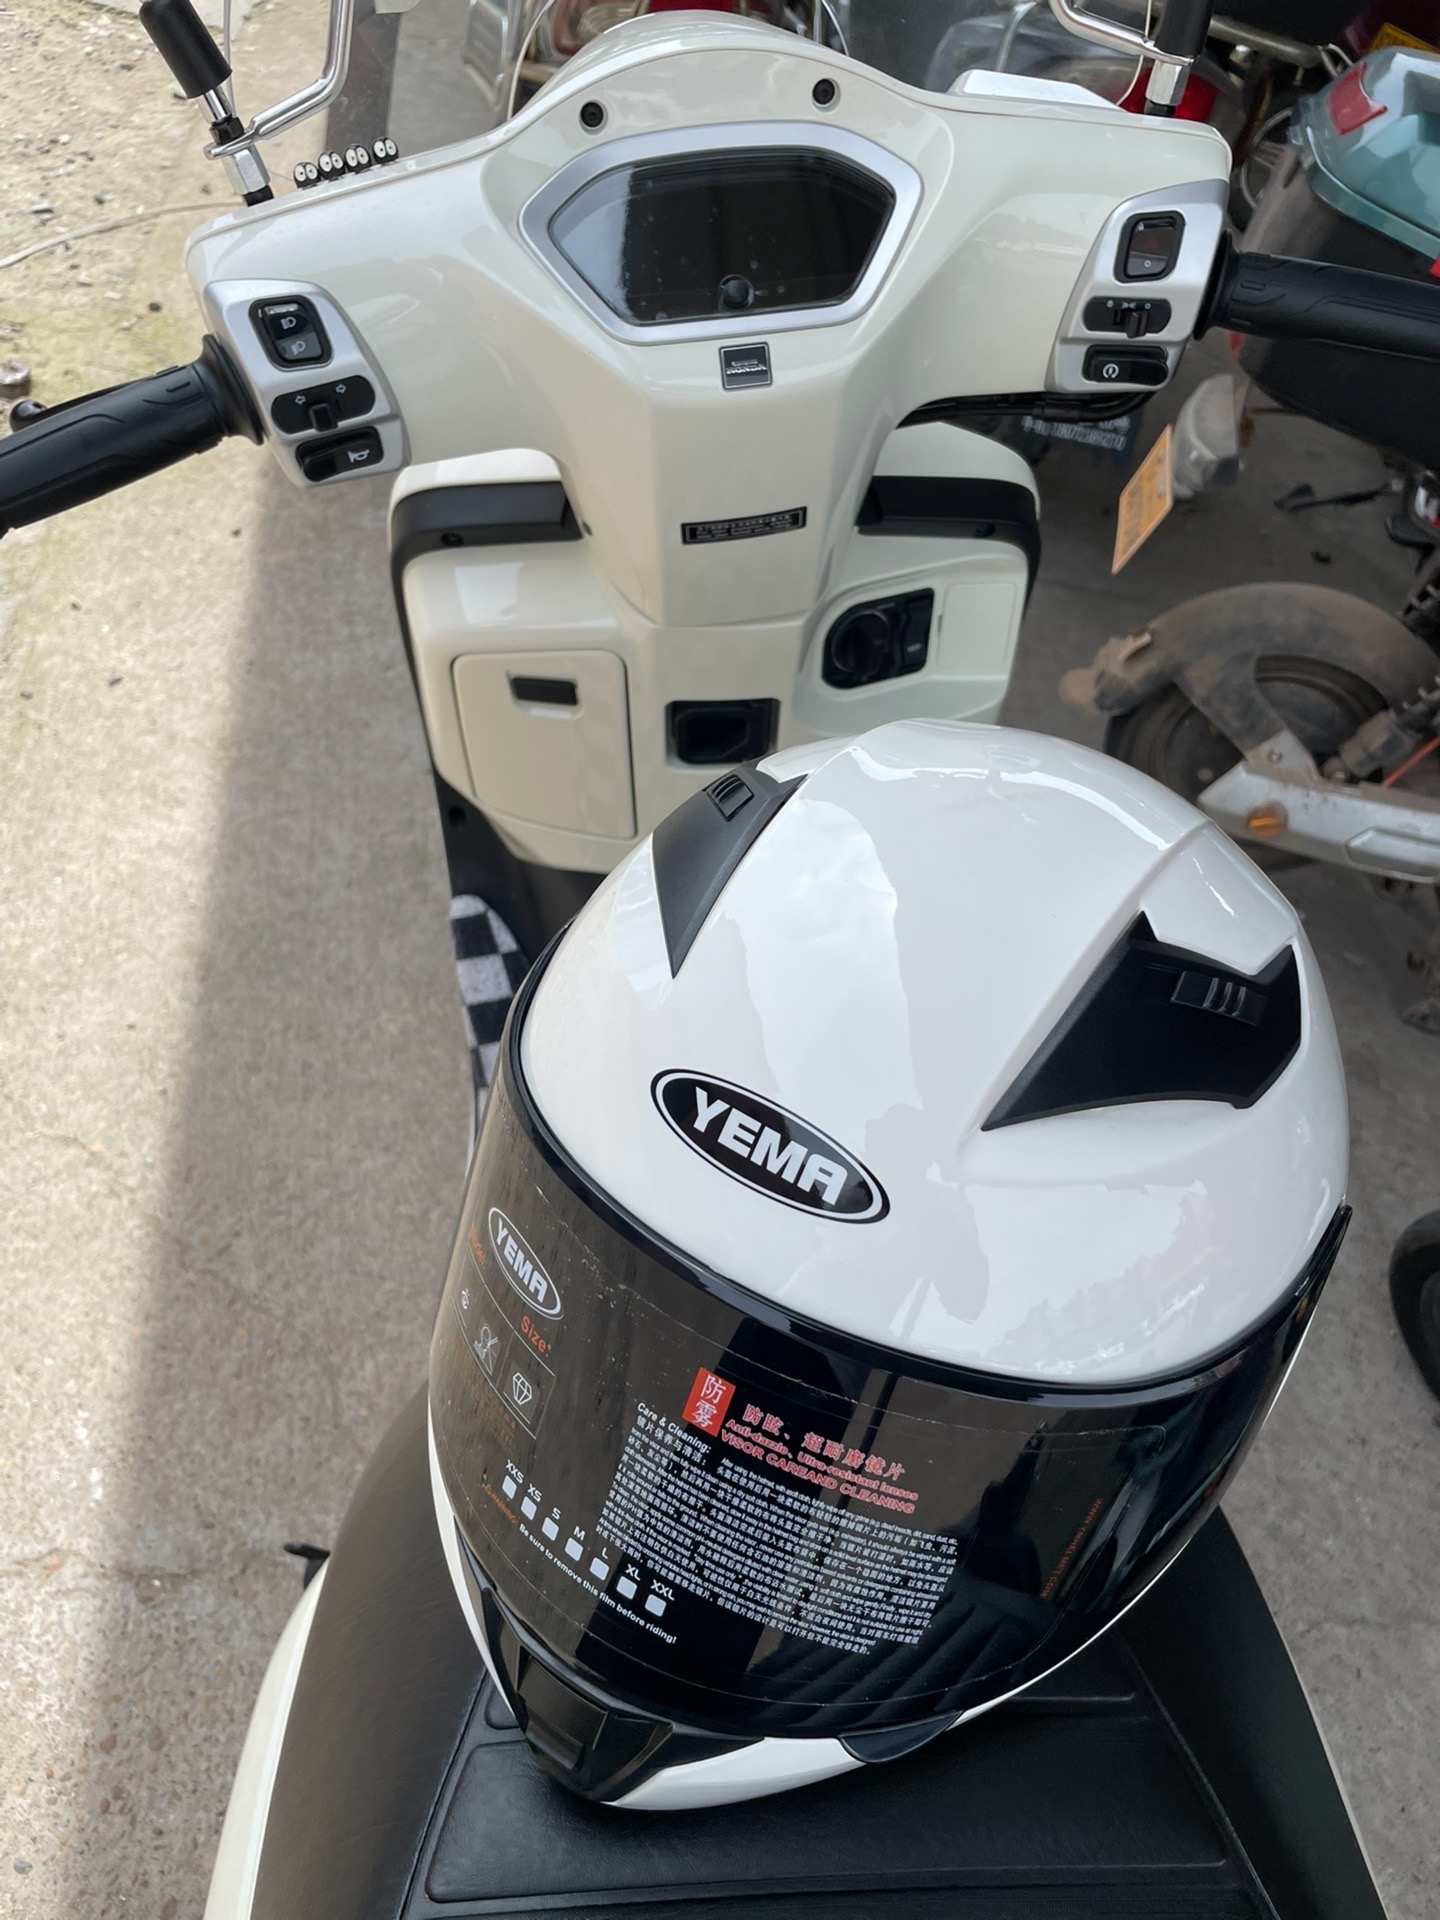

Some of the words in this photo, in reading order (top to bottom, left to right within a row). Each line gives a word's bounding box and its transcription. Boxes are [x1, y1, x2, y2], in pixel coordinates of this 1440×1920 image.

[693, 1086, 848, 1206] YEMA
[496, 1218, 548, 1303] YEMA
[521, 1315, 552, 1357] Size:
[692, 1374, 727, 1427] 防雾
[638, 1402, 658, 1421] Care
[658, 1416, 668, 1427] &
[668, 1422, 711, 1454] Cleaning:
[505, 1459, 524, 1484] XXS
[721, 1429, 763, 1459] VISOR
[840, 1483, 916, 1514] CLEANING
[527, 1483, 542, 1502] XS
[879, 1482, 918, 1501] lenses
[551, 1507, 562, 1520] S
[573, 1525, 586, 1541] M
[601, 1547, 609, 1559] L
[519, 1523, 532, 1538] Be
[529, 1533, 545, 1552] sure
[544, 1549, 553, 1561] to
[553, 1557, 582, 1584] remove
[582, 1579, 599, 1597] this
[599, 1591, 616, 1609] film
[616, 1603, 645, 1627] before
[645, 1621, 677, 1645] riding!
[625, 1563, 642, 1581] XL
[650, 1579, 675, 1601] XXL
